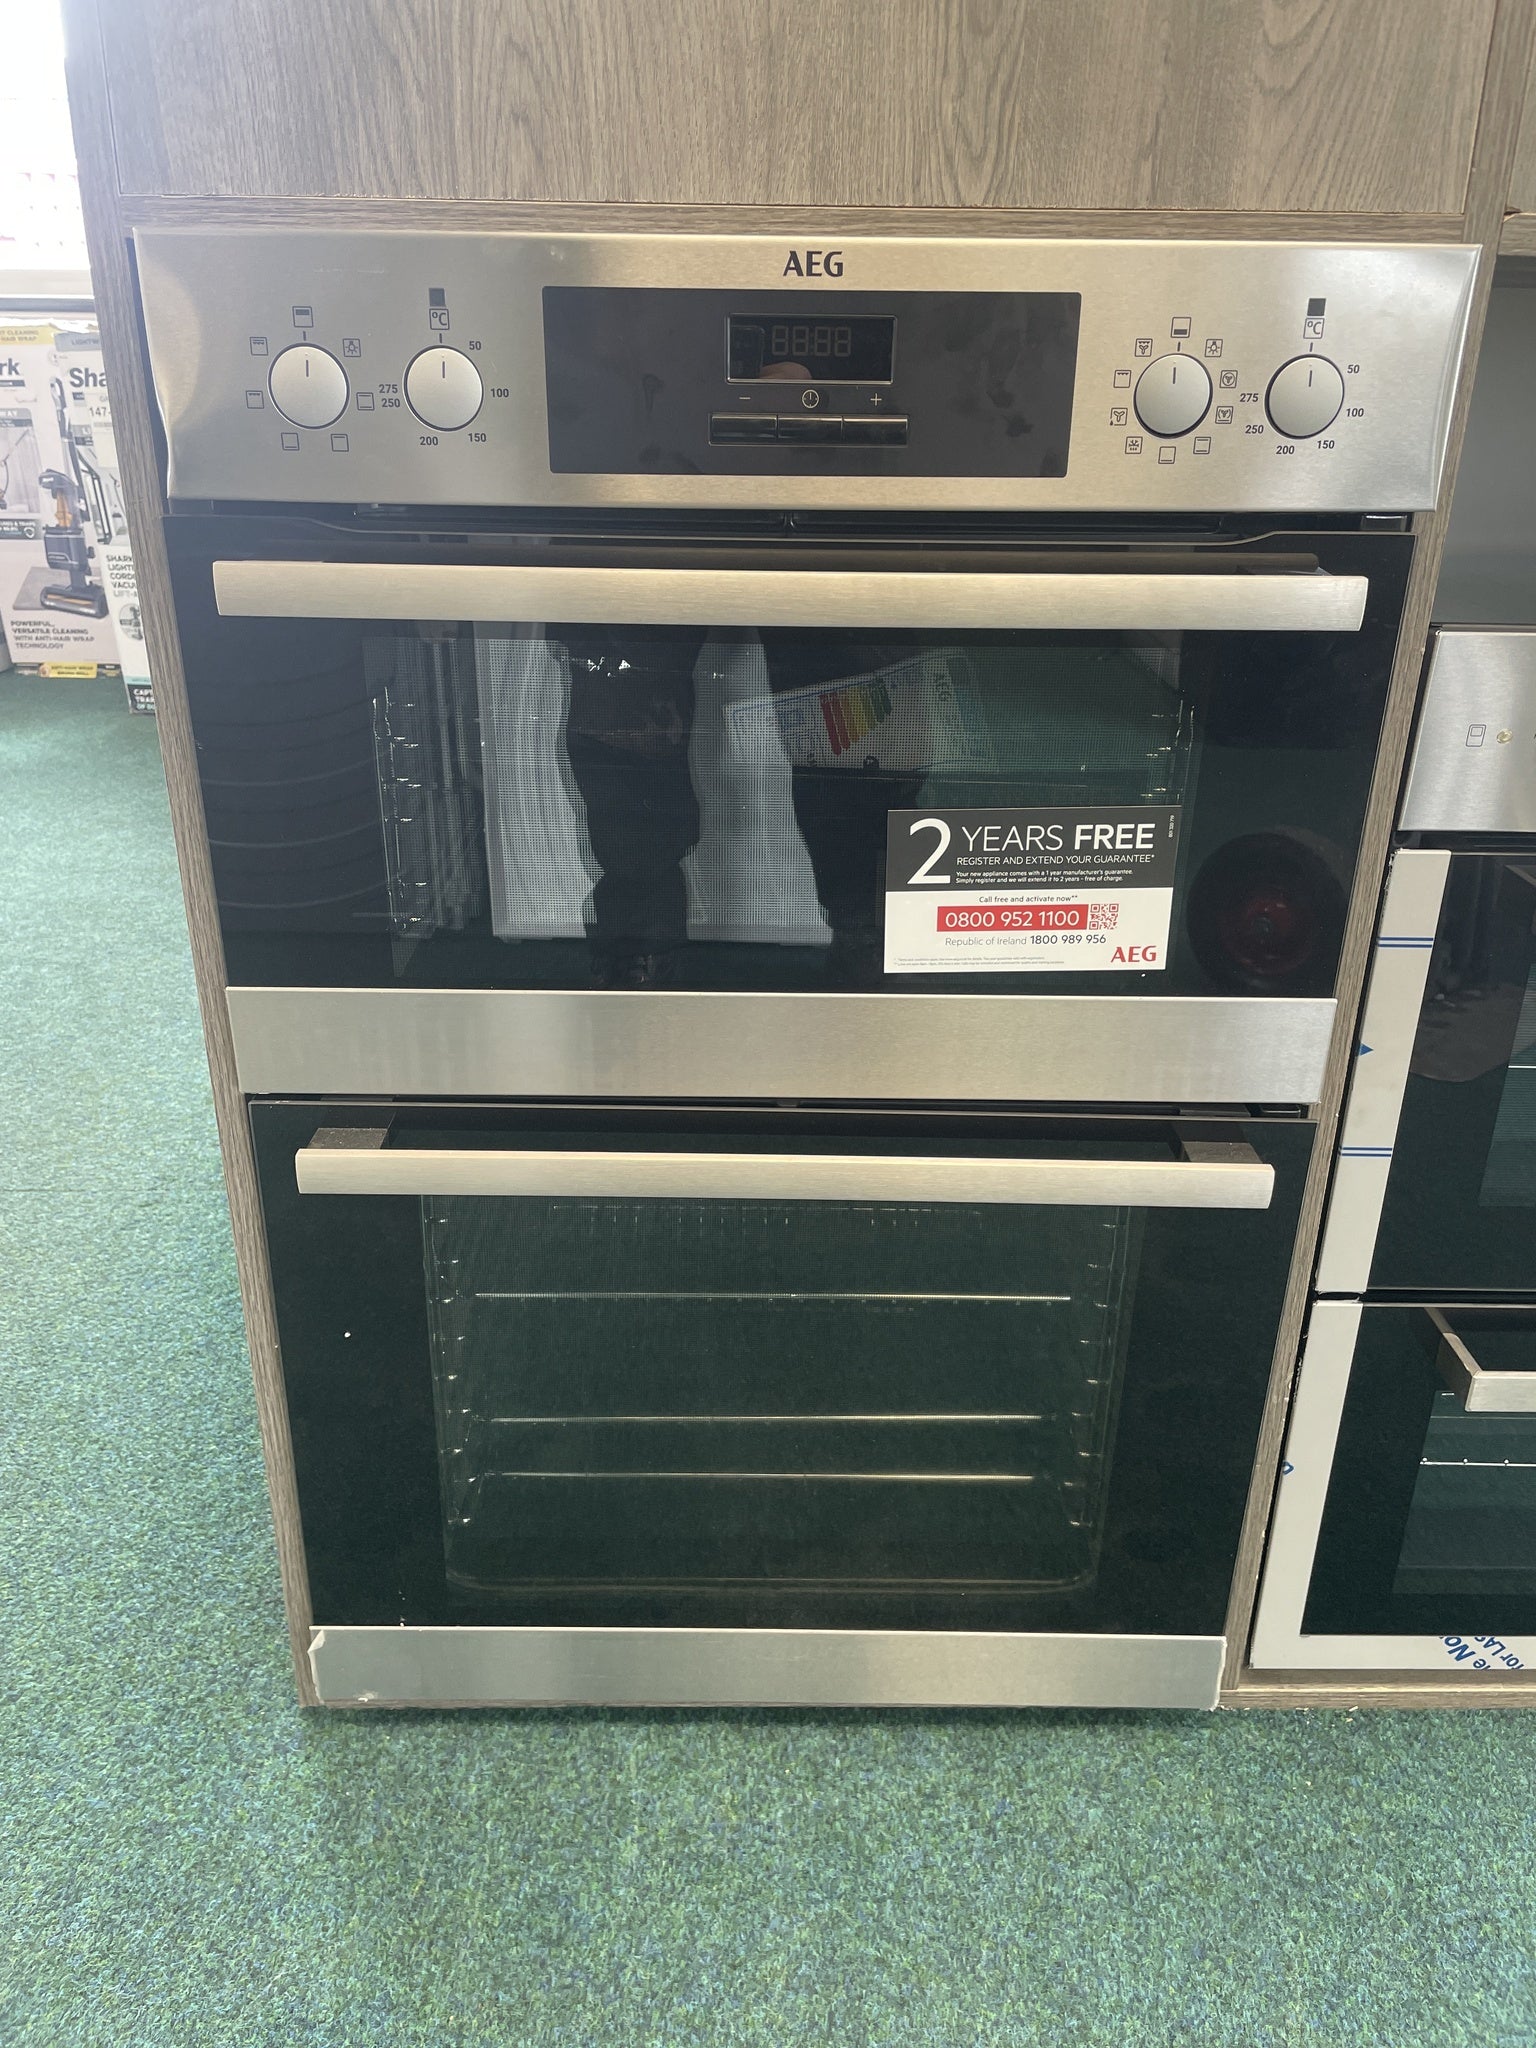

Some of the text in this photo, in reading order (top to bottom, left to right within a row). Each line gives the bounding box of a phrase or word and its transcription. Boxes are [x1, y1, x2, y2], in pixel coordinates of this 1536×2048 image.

[783, 250, 844, 277] AEG
[469, 340, 482, 351] 50
[1347, 364, 1360, 374] 50
[379, 384, 398, 394] 275
[491, 388, 509, 398] 100
[381, 398, 400, 408] 250
[1240, 393, 1259, 403] 275
[1346, 408, 1364, 418] 100
[1245, 424, 1264, 435] 250
[419, 436, 439, 446] 200
[468, 433, 487, 443] 150
[1276, 445, 1295, 455] 200
[1317, 440, 1335, 450] 150
[907, 817, 1156, 884] 2 YEARS FREE
[956, 857, 1001, 866] REGISTER
[1002, 856, 1024, 865] AND
[1025, 855, 1064, 865] EXTEND
[1065, 855, 1092, 864] YOUR
[1104, 869, 1133, 877] guarantee.
[994, 895, 1009, 903] free
[1010, 895, 1024, 903] and
[945, 910, 1080, 928] 0800 952 1100
[945, 934, 1107, 947] Republic of Ireland 1800 989 956
[1111, 945, 1157, 963] AEG
